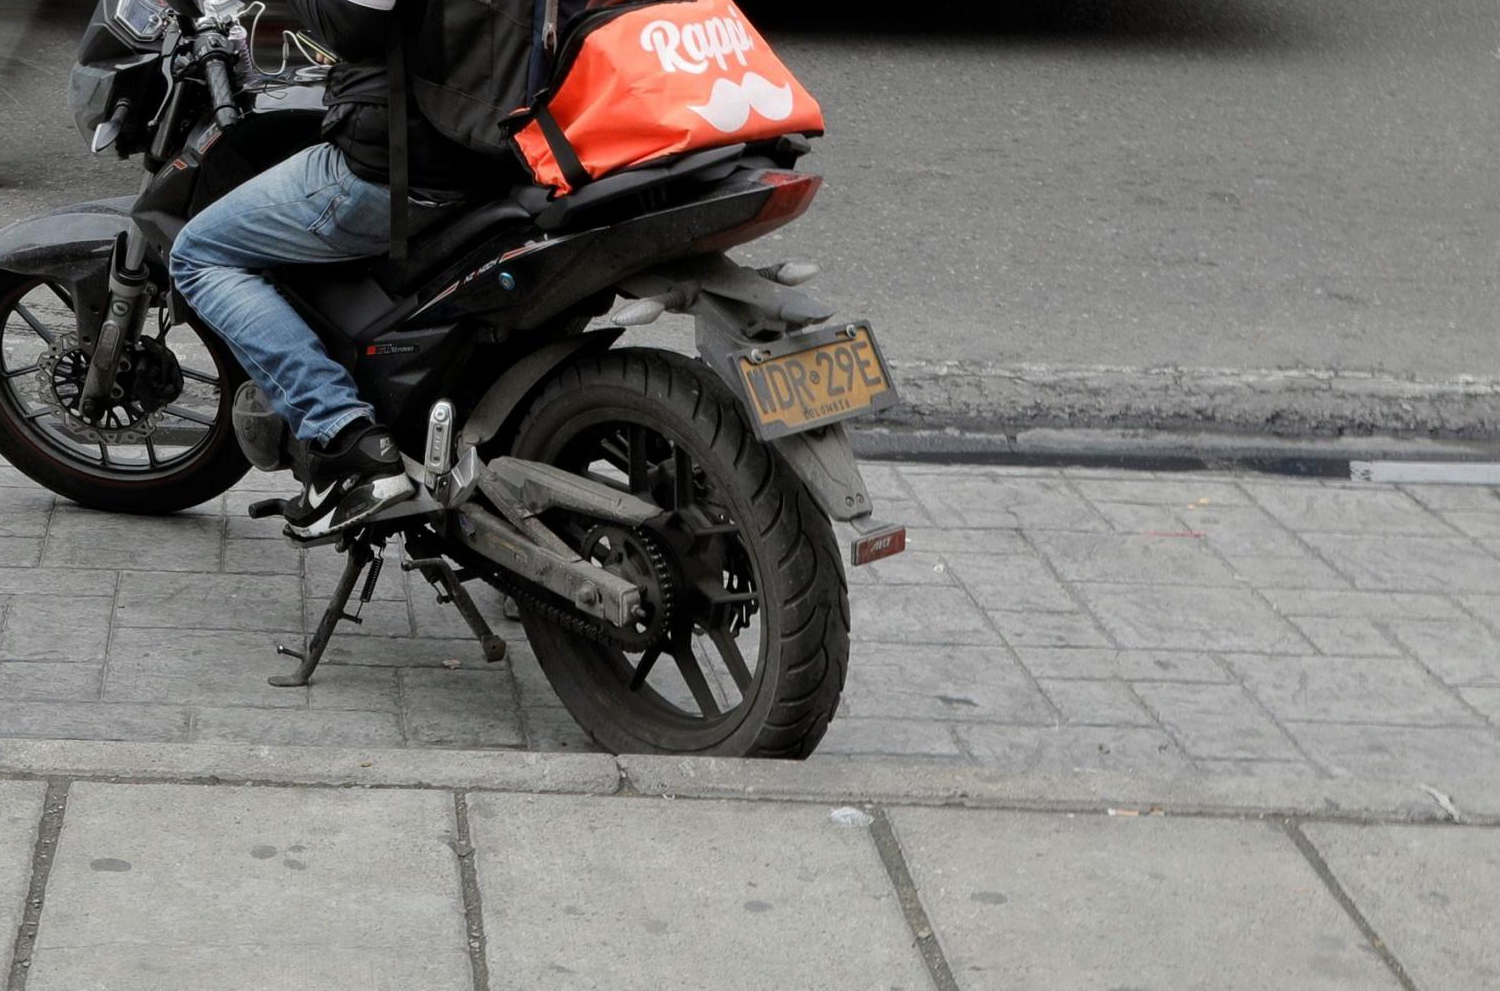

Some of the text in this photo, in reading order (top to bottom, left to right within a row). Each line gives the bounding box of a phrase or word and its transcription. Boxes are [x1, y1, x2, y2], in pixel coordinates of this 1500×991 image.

[640, 6, 754, 73] Rappi
[747, 341, 881, 415] WDR 29E
